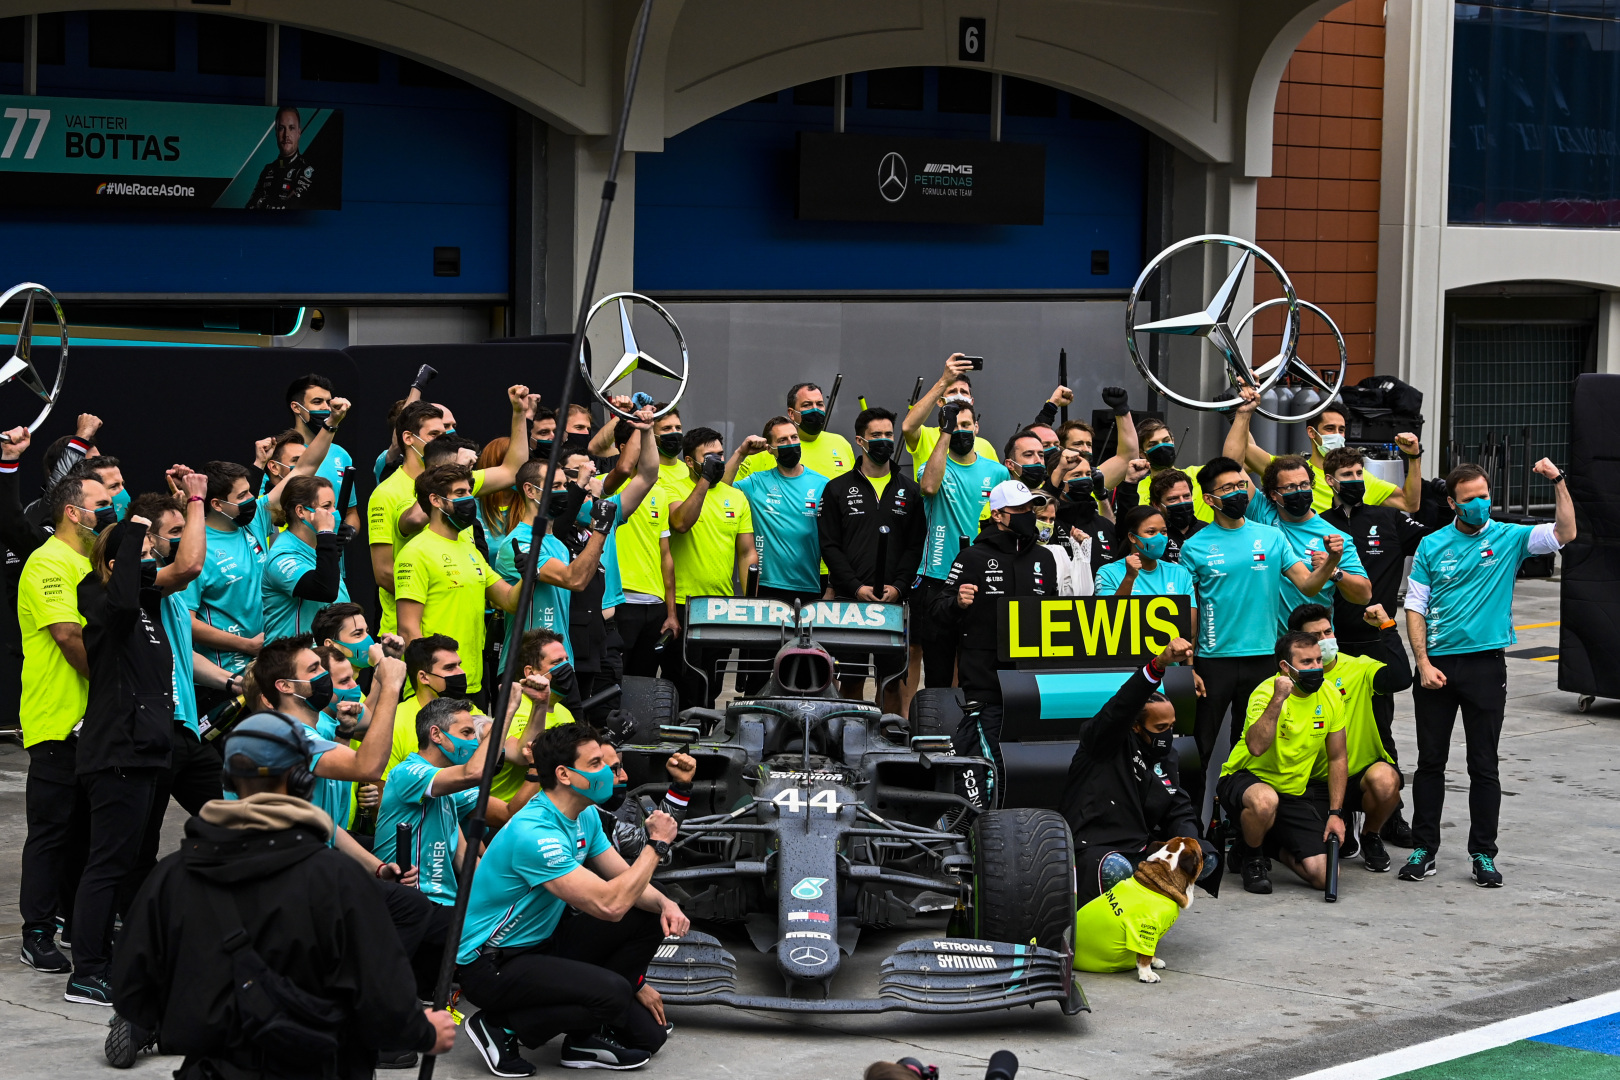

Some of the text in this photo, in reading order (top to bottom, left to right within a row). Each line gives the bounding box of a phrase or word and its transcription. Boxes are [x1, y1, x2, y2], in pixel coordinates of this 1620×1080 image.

[965, 26, 979, 54] 6
[1, 108, 51, 160] 77
[65, 114, 128, 130] VALTTERI
[65, 132, 180, 162] BOTTAS
[914, 175, 973, 187] PETRONAS
[938, 163, 973, 174] AMG
[106, 182, 195, 197] #WeRaceAsOne
[922, 187, 973, 197] FORMULA ONE TEAM
[755, 535, 765, 575] WINNER
[932, 525, 946, 566] WINNER
[544, 607, 554, 631] NER
[706, 598, 886, 627] PETRONAS
[1206, 603, 1217, 649] WINNER
[1009, 596, 1181, 658] LEWIS
[1430, 607, 1440, 648] WINNER
[769, 788, 843, 814] 44
[431, 841, 446, 894] WINNER
[933, 941, 994, 953] PETRONAS
[937, 954, 998, 969] SYNTIUM
